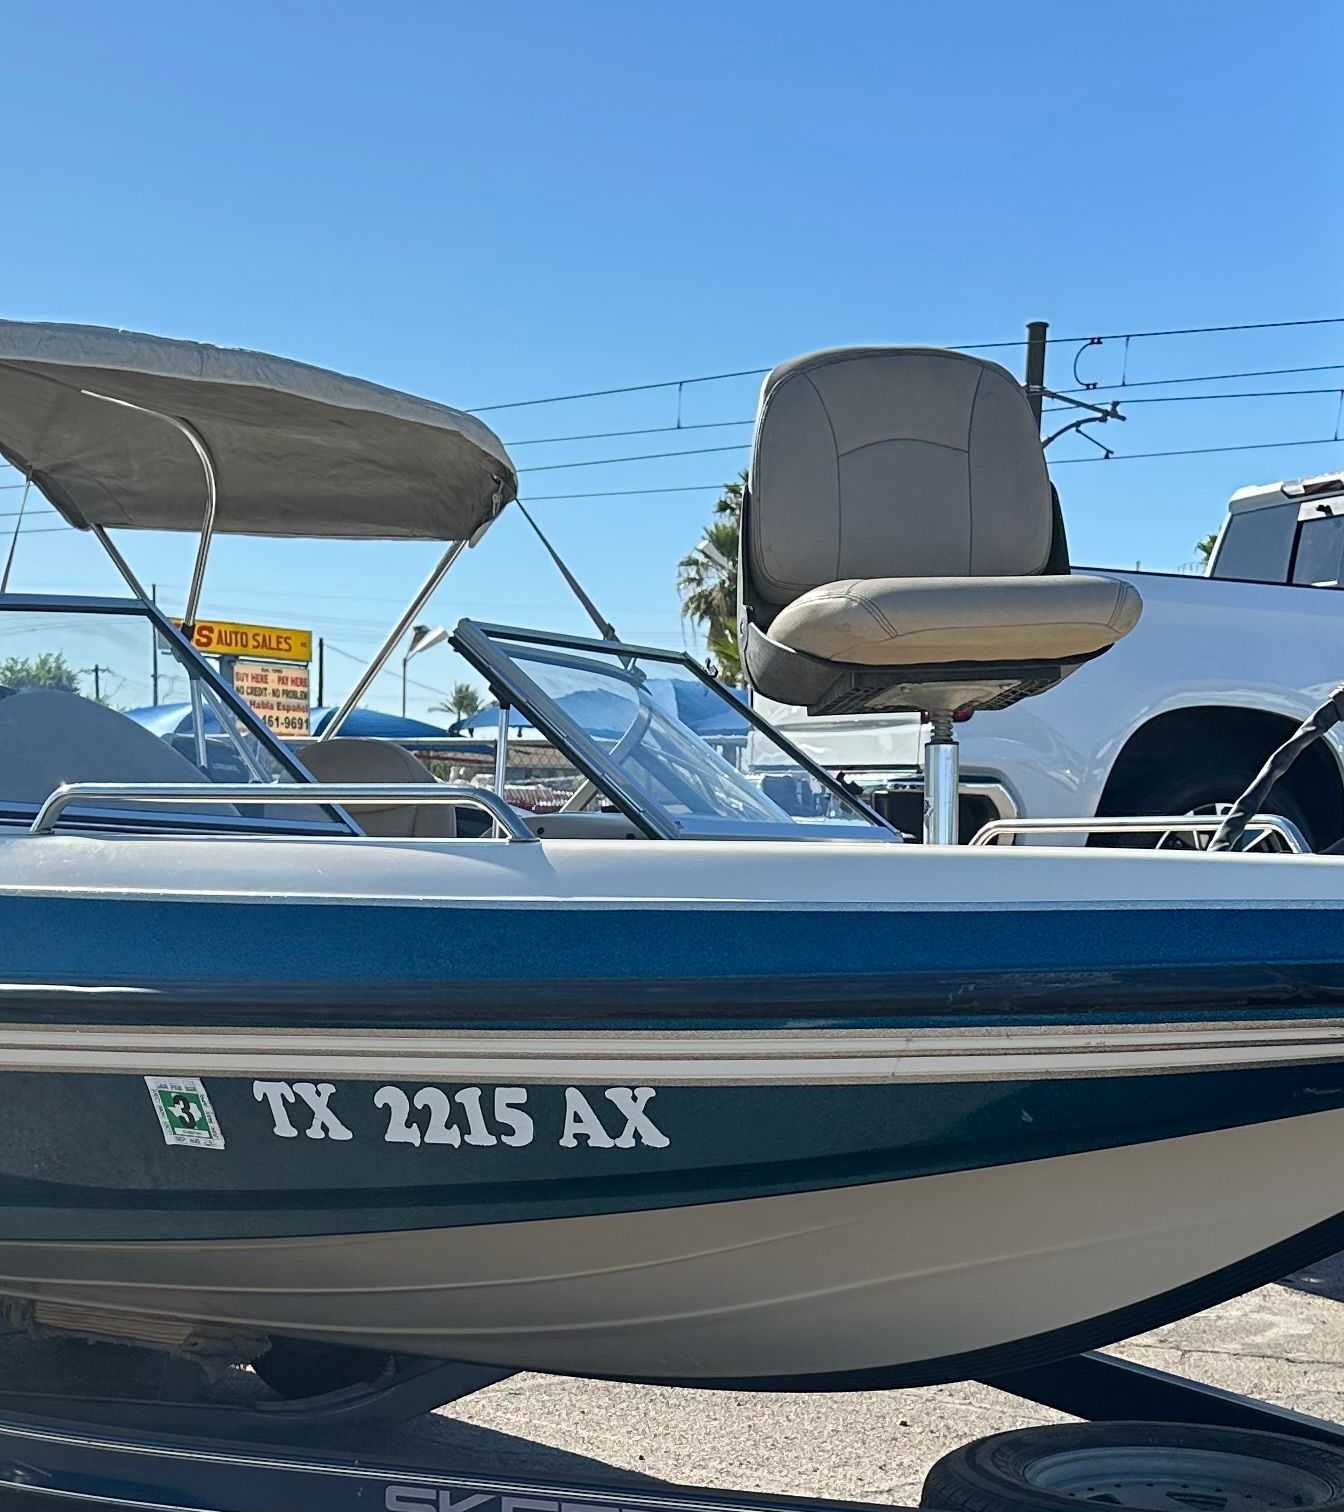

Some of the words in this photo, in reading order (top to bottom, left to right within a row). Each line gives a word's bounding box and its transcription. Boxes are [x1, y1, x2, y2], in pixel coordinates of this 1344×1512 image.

[216, 629, 248, 648] AUTO
[252, 633, 292, 652] SALES
[235, 671, 249, 682] BUY
[251, 672, 268, 684] HERE
[277, 675, 288, 686] PAY
[290, 676, 307, 688] HERE
[246, 686, 267, 697] CREDIT
[272, 688, 280, 698] NO
[172, 1095, 196, 1129] 3
[253, 1080, 353, 1141] TX
[374, 1085, 533, 1148] 2215
[559, 1086, 670, 1148] AX
